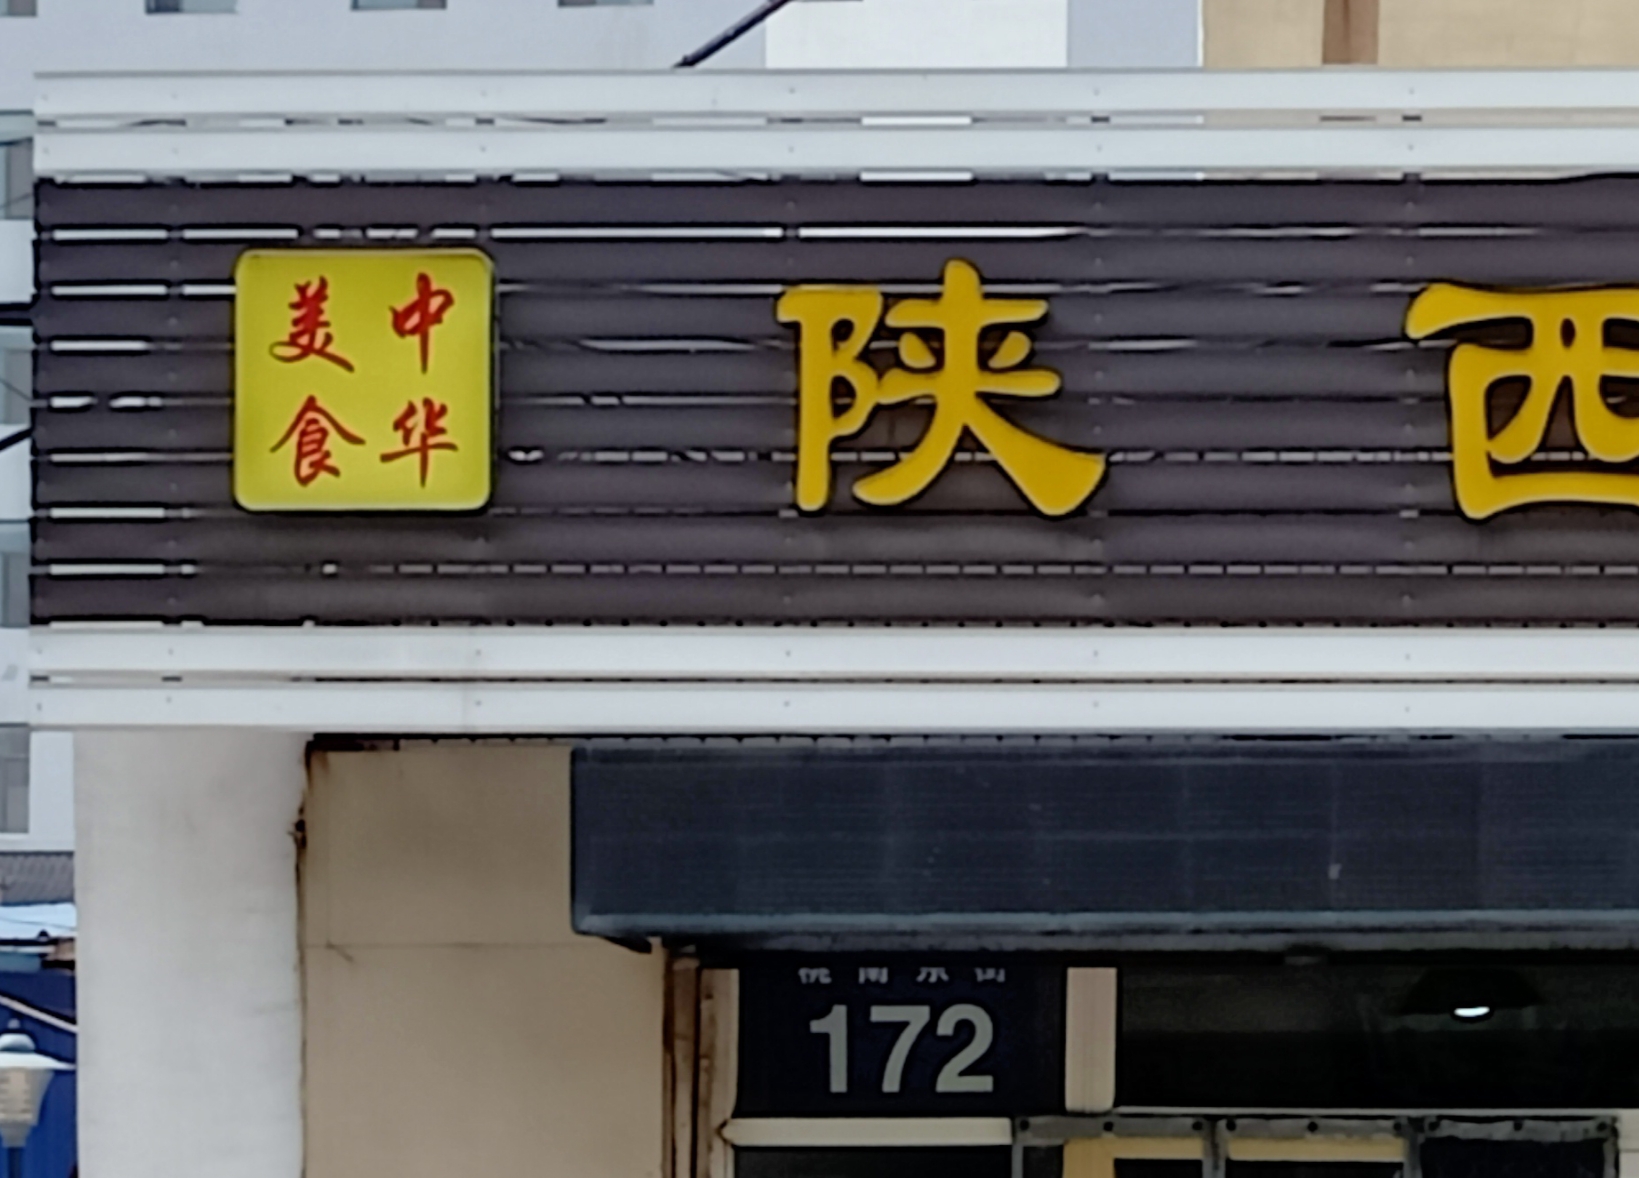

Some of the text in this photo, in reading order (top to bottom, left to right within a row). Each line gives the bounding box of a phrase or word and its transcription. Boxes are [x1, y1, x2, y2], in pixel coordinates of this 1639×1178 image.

[269, 275, 365, 486] 美食
[380, 272, 458, 488] 中华
[809, 1003, 995, 1093] 172
